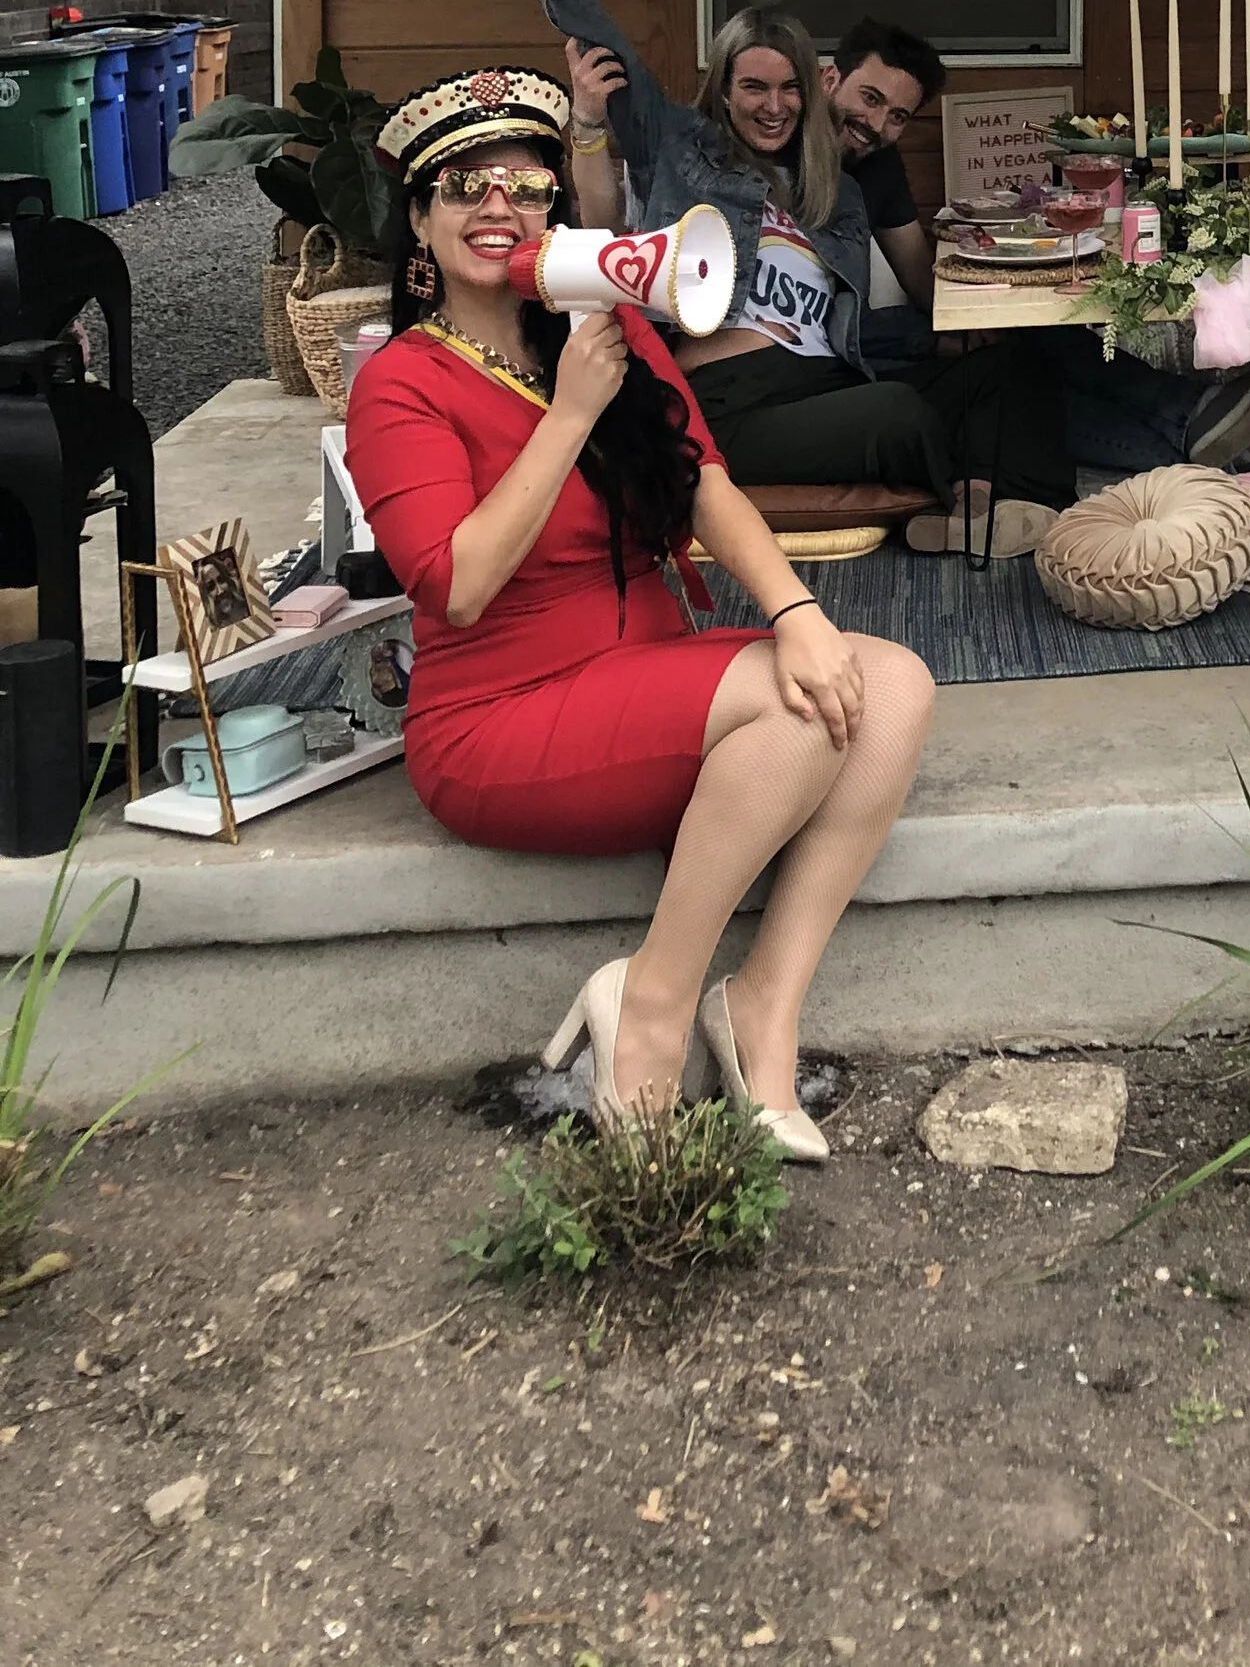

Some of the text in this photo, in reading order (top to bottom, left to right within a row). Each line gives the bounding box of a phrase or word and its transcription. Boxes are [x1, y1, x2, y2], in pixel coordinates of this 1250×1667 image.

[964, 113, 1012, 128] WHAT
[979, 131, 1048, 148] HAPPEN
[967, 152, 1048, 170] IN VEGAS
